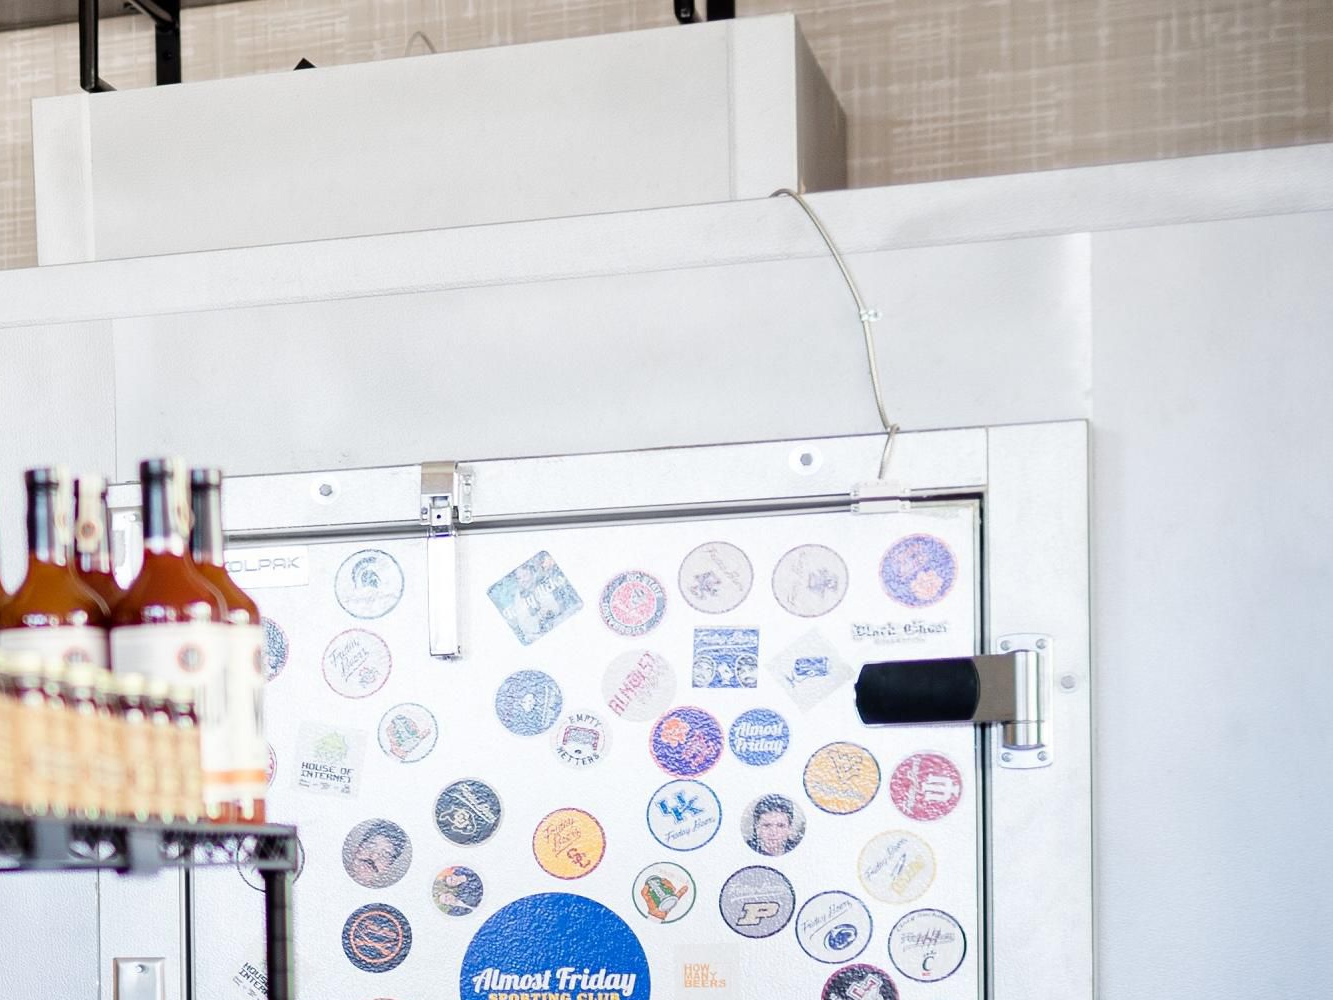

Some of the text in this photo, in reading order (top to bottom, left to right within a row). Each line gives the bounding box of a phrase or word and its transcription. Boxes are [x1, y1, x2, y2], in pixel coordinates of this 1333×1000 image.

[569, 713, 601, 728] EMPTY
[737, 721, 782, 737] Almost
[736, 737, 783, 756] Friday
[556, 746, 600, 766] NETTERS
[301, 762, 355, 776] HOUSE OF
[684, 963, 710, 972] HOW
[472, 967, 636, 996] Almost Friday
[684, 971, 718, 981] MANY
[684, 979, 726, 988] BEERS
